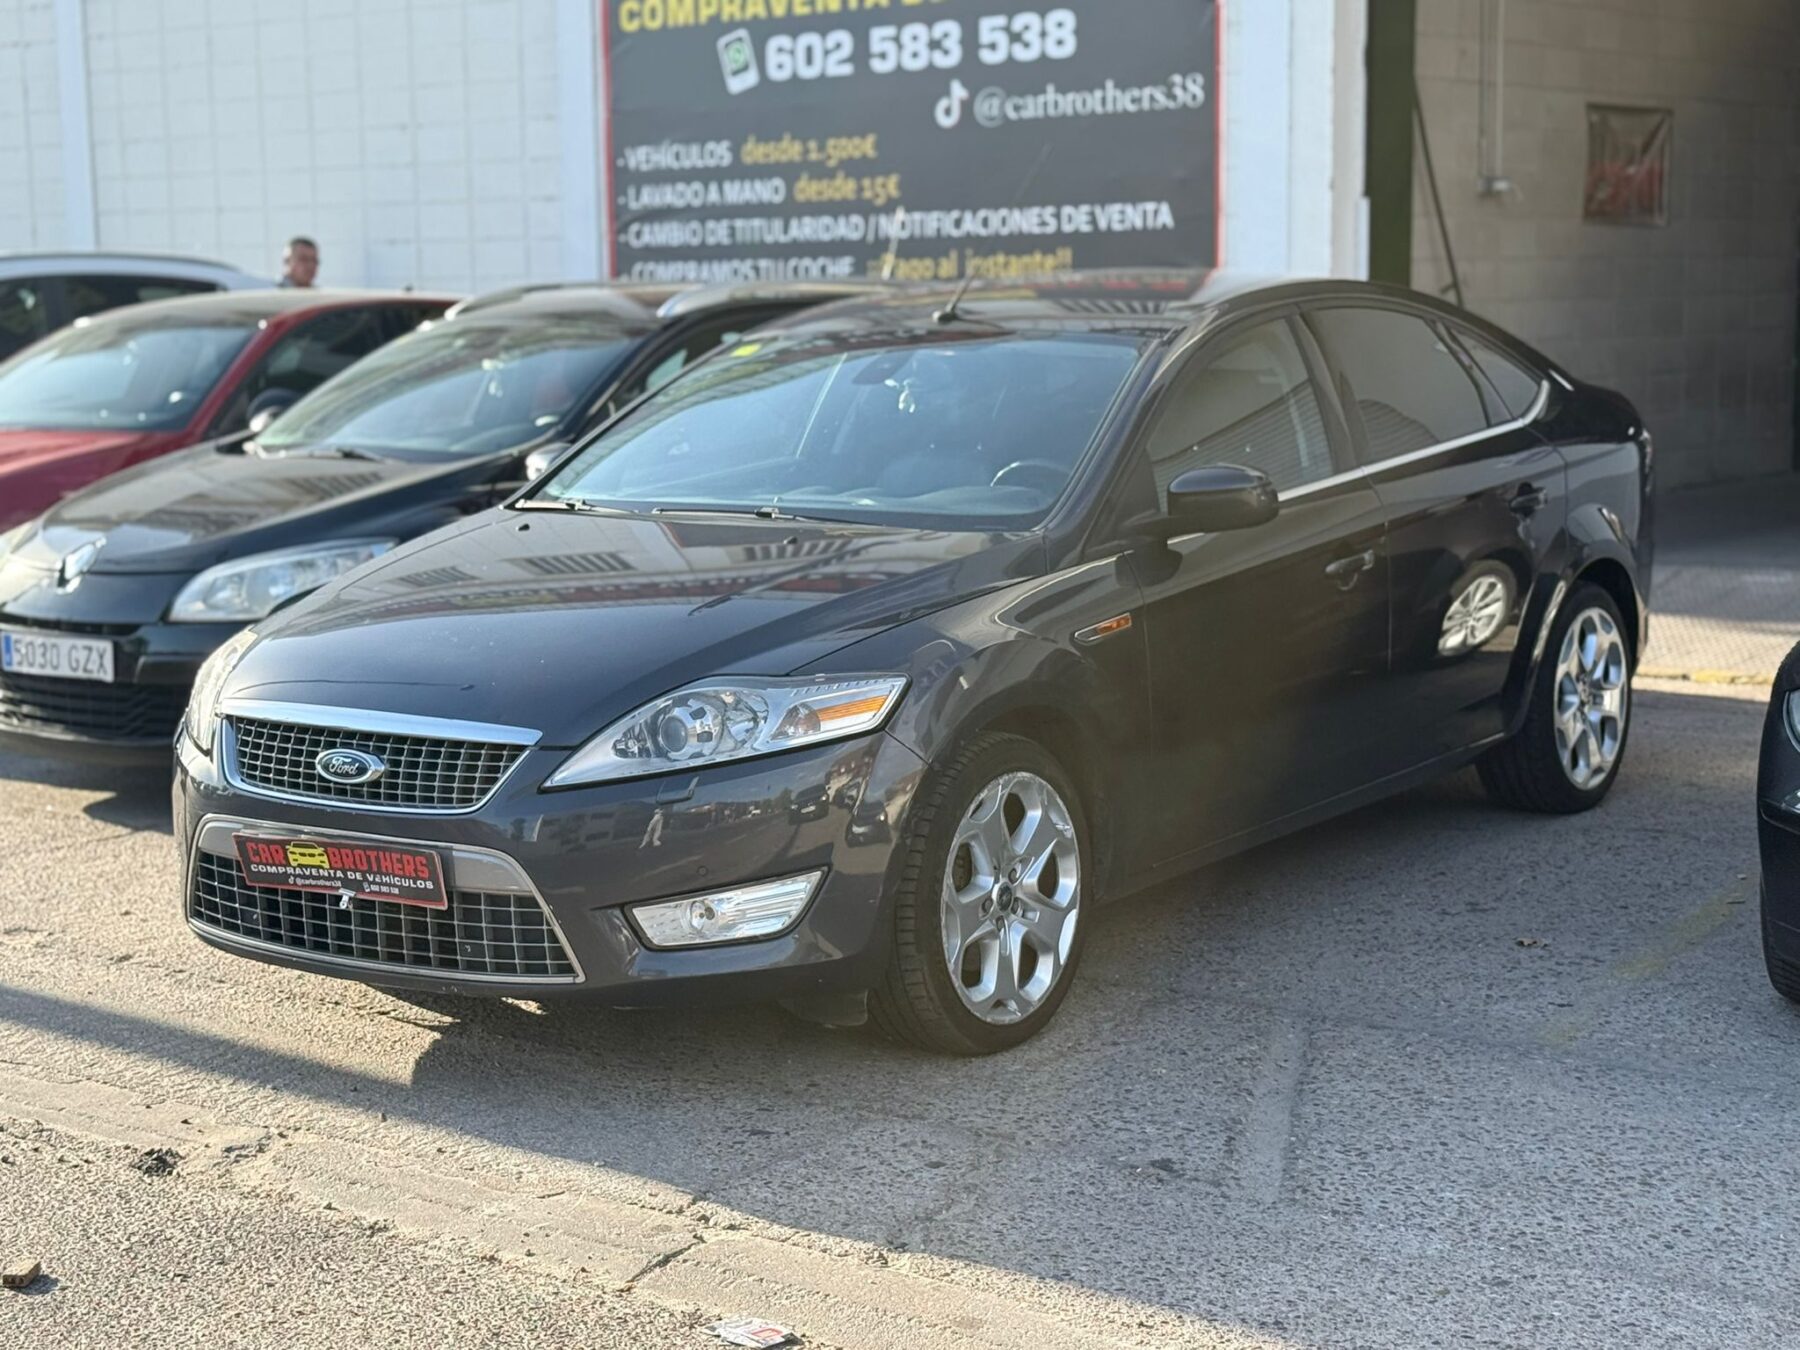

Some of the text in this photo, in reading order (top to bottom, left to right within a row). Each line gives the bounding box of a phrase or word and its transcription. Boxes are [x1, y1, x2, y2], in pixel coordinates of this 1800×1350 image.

[764, 8, 1077, 82] 602 583 538
[973, 72, 1205, 128] @carbrothers38
[741, 131, 803, 165] desde
[705, 181, 721, 206] A
[723, 176, 786, 206] MANO
[794, 170, 857, 202] desde
[862, 172, 900, 207] 15€
[704, 217, 731, 246] DE
[732, 213, 866, 245] TITULARIDAD
[878, 204, 1058, 240] NOTIFICACIONES
[1060, 201, 1093, 234] DE
[1094, 200, 1174, 232] VENTA
[14, 639, 108, 676] 5030 GZX
[328, 756, 359, 775] Ford
[246, 842, 429, 879] CAR BROTHERS
[250, 863, 344, 879] COMPRAVENTA
[347, 871, 363, 881] DE
